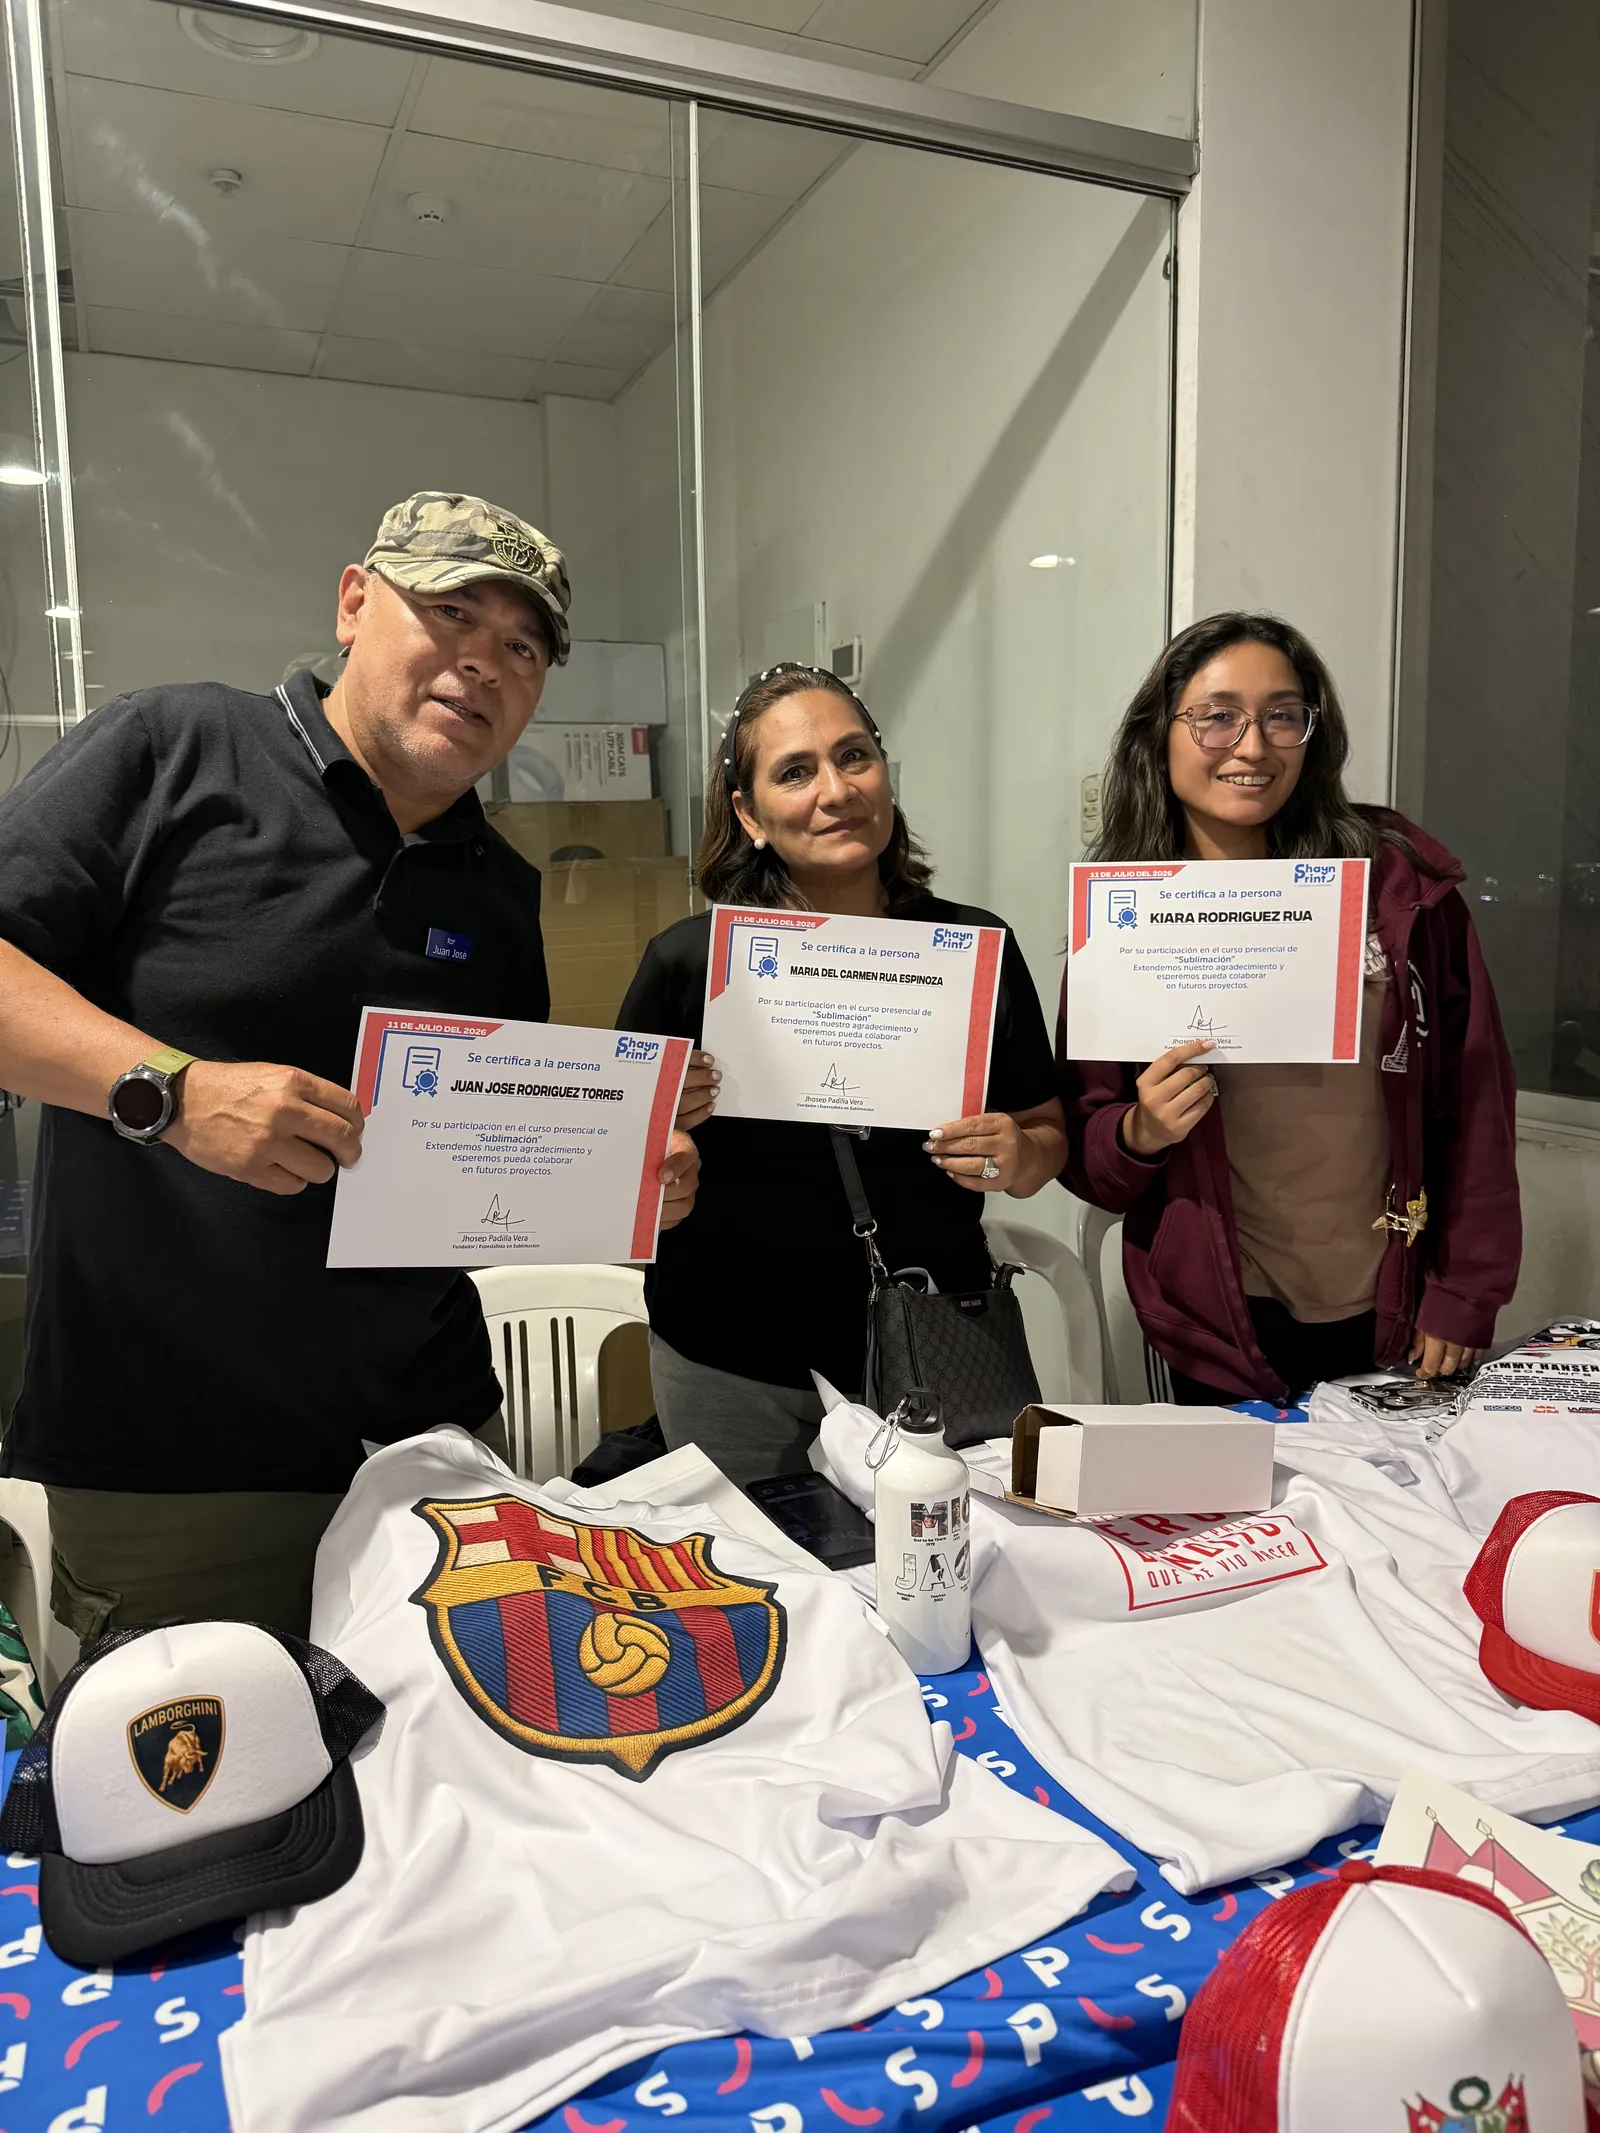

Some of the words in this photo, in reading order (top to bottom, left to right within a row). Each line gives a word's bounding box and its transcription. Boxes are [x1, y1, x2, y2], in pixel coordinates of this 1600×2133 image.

[606, 731, 615, 749] UTP
[607, 750, 617, 777] CABLE
[1294, 863, 1335, 876] Shayn
[1294, 872, 1326, 883] Print
[1159, 890, 1172, 899] Se
[1174, 889, 1216, 899] certifica
[1228, 889, 1237, 898] la
[1240, 890, 1282, 899] persona
[1150, 912, 1195, 924] KIARA
[1198, 911, 1281, 923] RODRIGUEZ
[1283, 910, 1313, 921] RUA
[932, 936, 964, 949] Print
[933, 927, 973, 943] Shayn
[432, 945, 451, 957] Juan
[452, 948, 468, 960] José
[801, 941, 813, 951] Se
[816, 944, 856, 954] certifica
[868, 946, 877, 956] la
[880, 949, 920, 959] persona
[1245, 945, 1285, 953] presencial
[1215, 963, 1278, 971] agradecimiento
[790, 965, 820, 977] MARIA
[821, 968, 839, 978] DEL
[839, 969, 878, 981] CARMEN
[879, 972, 898, 982] RUA
[899, 973, 943, 986] ESPINOZA
[1201, 972, 1227, 980] pueda
[1208, 982, 1249, 990] proyectos.
[758, 997, 772, 1005] Por
[858, 1005, 879, 1013] curso
[881, 1007, 920, 1016] presencial
[921, 1009, 932, 1017] de
[414, 1023, 442, 1032] JULIO
[463, 1027, 486, 1035] 2026
[771, 1016, 819, 1027] Extendemos
[820, 1021, 850, 1029] nuestro
[852, 1023, 912, 1033] agradecimiento
[793, 1028, 836, 1037] esperemos
[864, 1032, 901, 1041] colaborar
[614, 1044, 648, 1060] Print
[617, 1036, 659, 1053] Shayn
[814, 1038, 842, 1047] futuros
[844, 1041, 883, 1050] proyectos.
[467, 1052, 482, 1063] Se
[485, 1055, 531, 1066] certifica
[533, 1059, 541, 1067] a
[544, 1058, 554, 1068] la
[556, 1061, 601, 1071] persona
[450, 1079, 484, 1093] JUAN
[484, 1081, 516, 1095] JOSE
[516, 1083, 581, 1098] RODRIGUEZ
[581, 1087, 624, 1101] TORRES
[849, 1098, 863, 1106] Vera
[411, 1119, 428, 1128] Por
[430, 1121, 441, 1129] su
[518, 1123, 526, 1132] el
[528, 1125, 552, 1133] curso
[553, 1126, 596, 1134] presencial
[597, 1127, 608, 1135] de
[425, 1141, 482, 1151] Extendemos
[519, 1145, 585, 1154] agradecimiento
[587, 1148, 593, 1156] y
[451, 1154, 501, 1163] esperemos
[503, 1155, 531, 1164] pueda
[533, 1155, 573, 1164] colaborar
[461, 1166, 473, 1174] en
[476, 1165, 507, 1174] futuros
[509, 1167, 553, 1176] proyectos.
[512, 1234, 528, 1242] Vera
[1486, 1362, 1534, 1371] TIMMY
[1540, 1362, 1600, 1372] HANSEN
[1146, 1568, 1183, 1588] QUE
[1216, 1554, 1248, 1573] VIO
[1250, 1541, 1300, 1563] NACER
[133, 1701, 219, 1737] LAMBORGHINI
[1140, 1900, 1192, 1942] S
[1135, 1973, 1187, 2021] S
[154, 1996, 201, 2044] S
[1006, 2002, 1059, 2067] P
[884, 2046, 939, 2111] S
[634, 2070, 688, 2116] S
